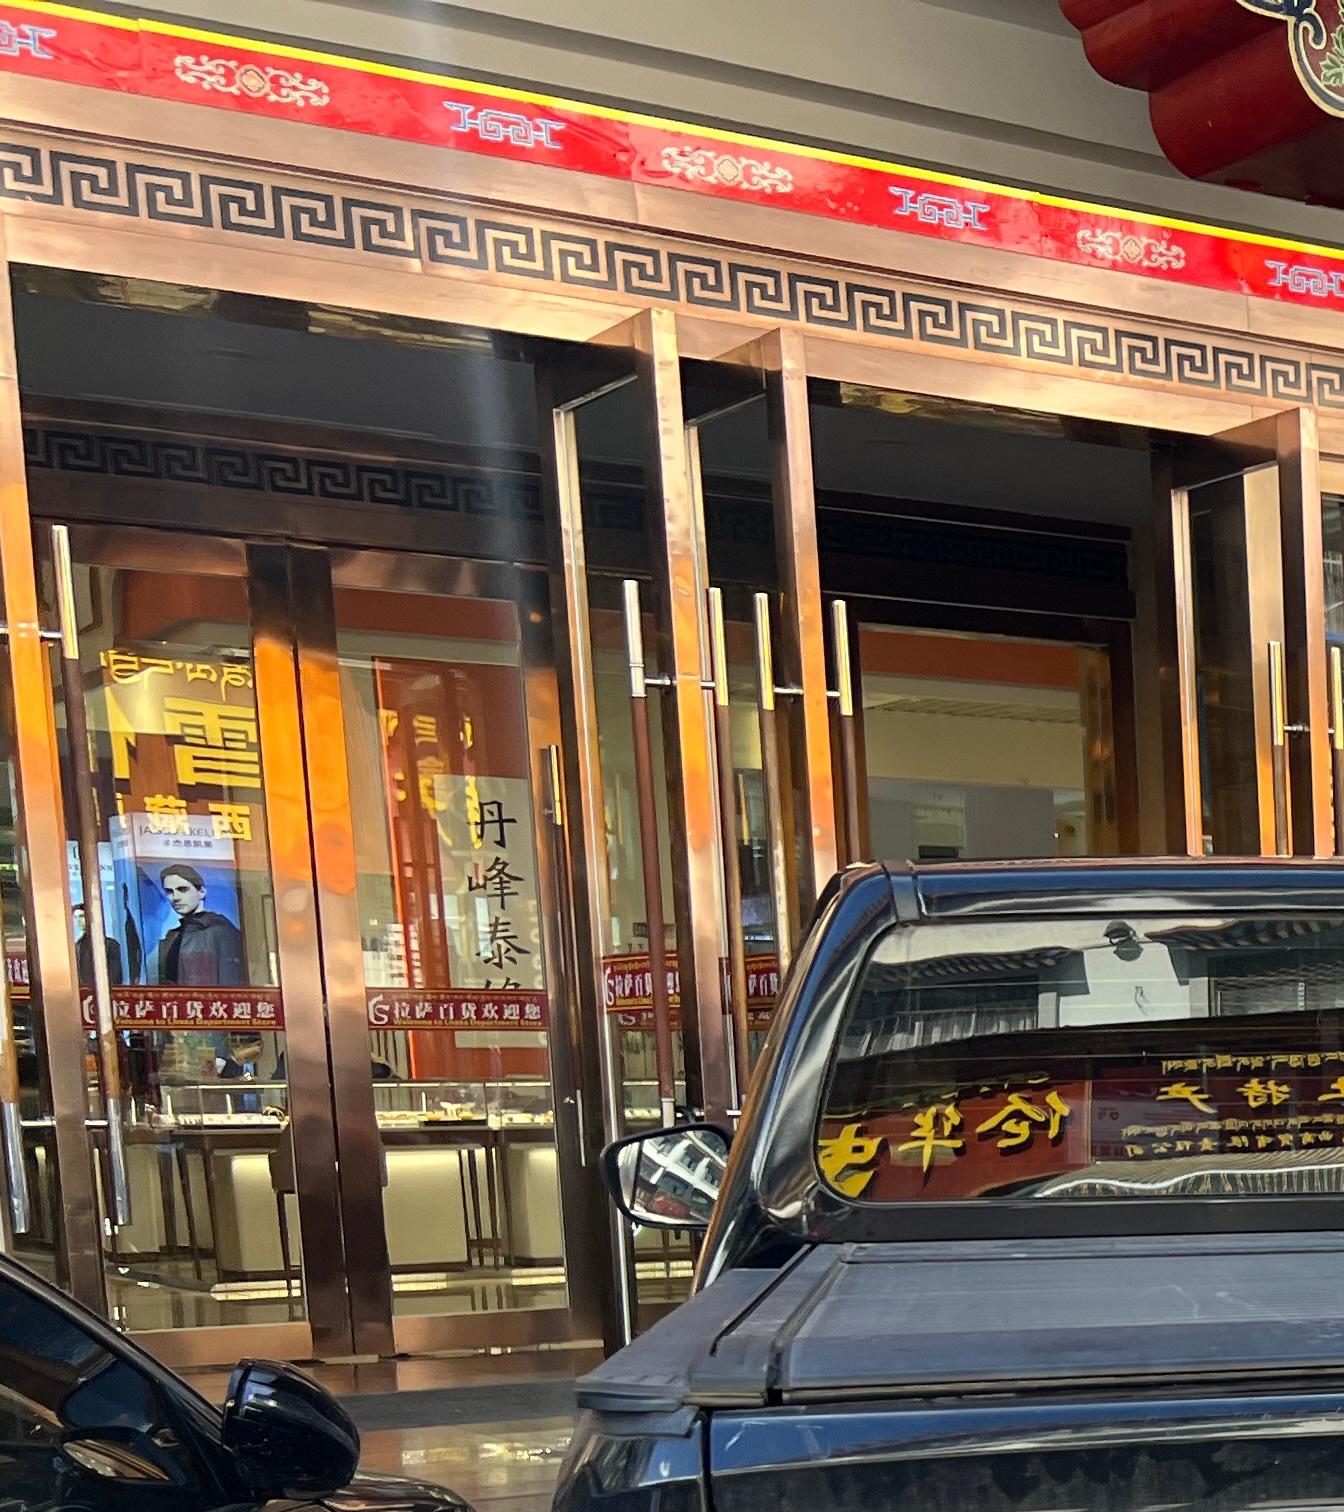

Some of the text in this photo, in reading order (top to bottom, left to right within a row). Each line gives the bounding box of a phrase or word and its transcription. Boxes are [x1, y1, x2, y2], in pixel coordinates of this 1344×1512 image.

[467, 799, 531, 989] 丹峰泰
[393, 1002, 542, 1020] 拉萨百货欢迎您
